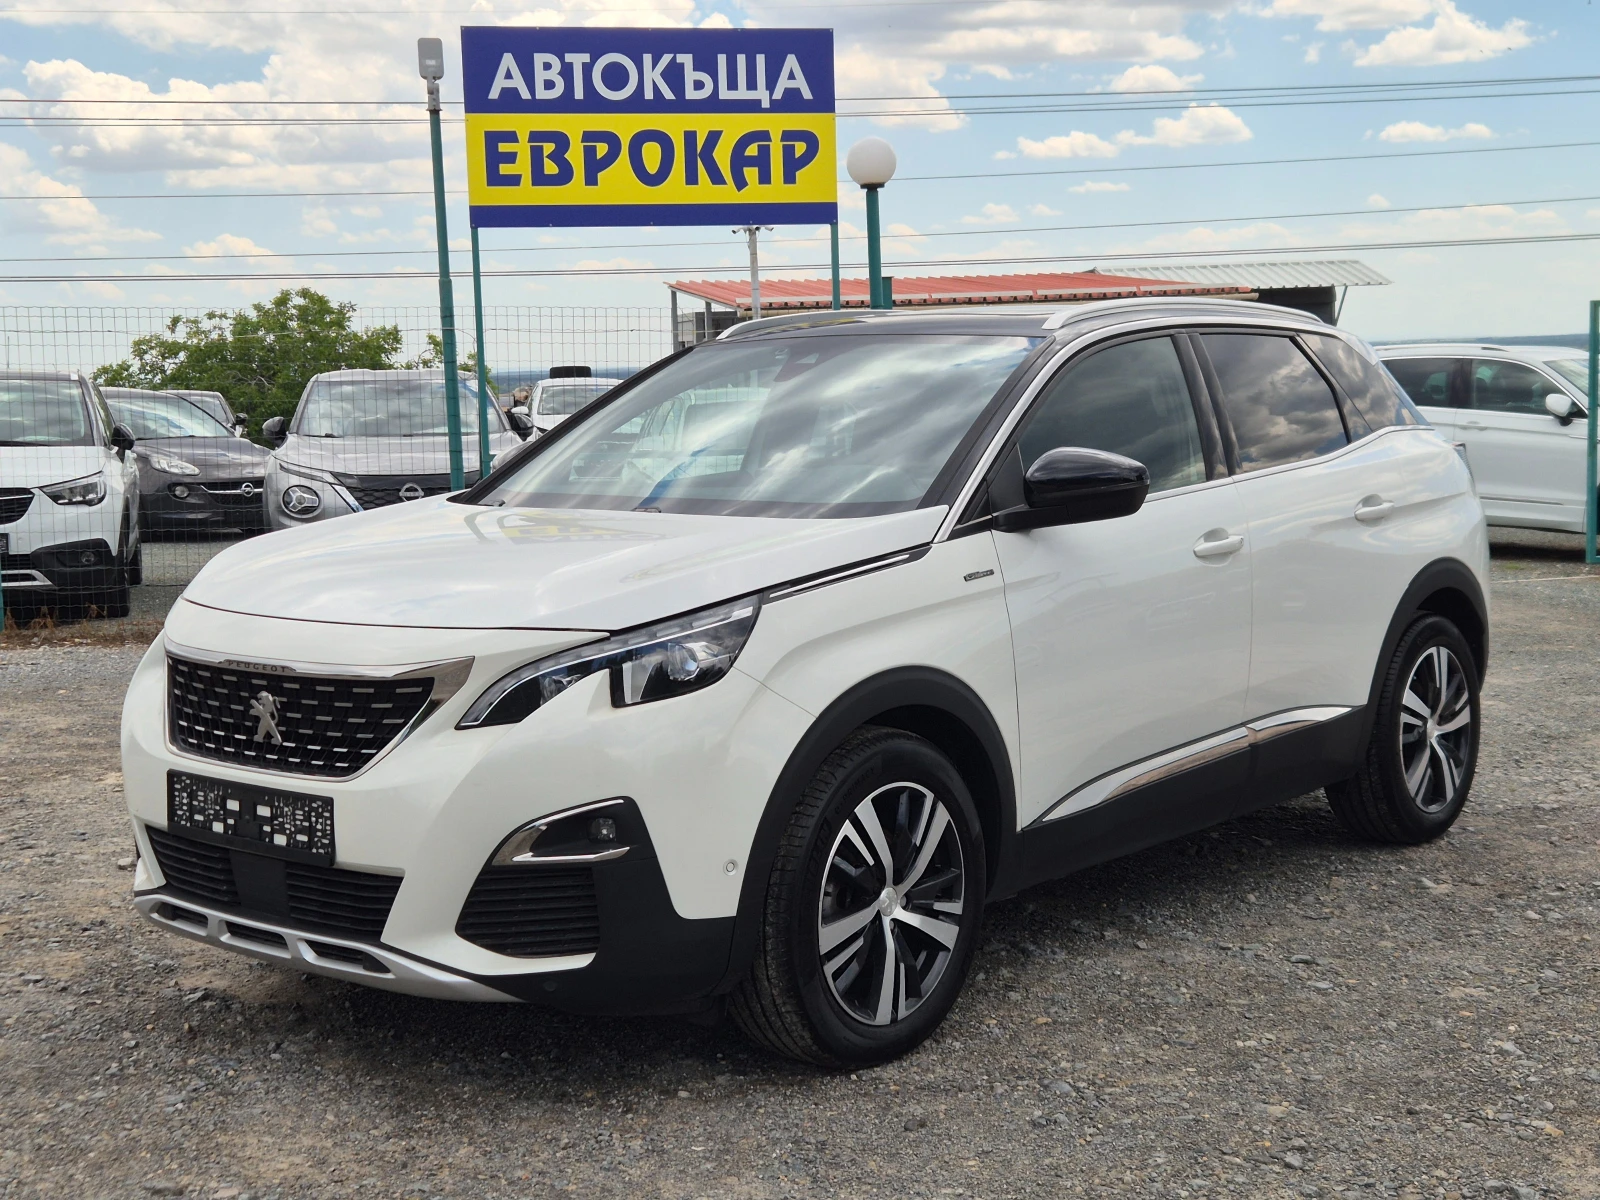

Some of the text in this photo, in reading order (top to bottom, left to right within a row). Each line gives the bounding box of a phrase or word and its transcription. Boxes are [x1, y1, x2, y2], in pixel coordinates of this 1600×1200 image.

[488, 52, 813, 108] АВТОКЪЩА
[484, 129, 820, 192] ЕВРОКАР
[227, 660, 287, 673] PEUGEOT
